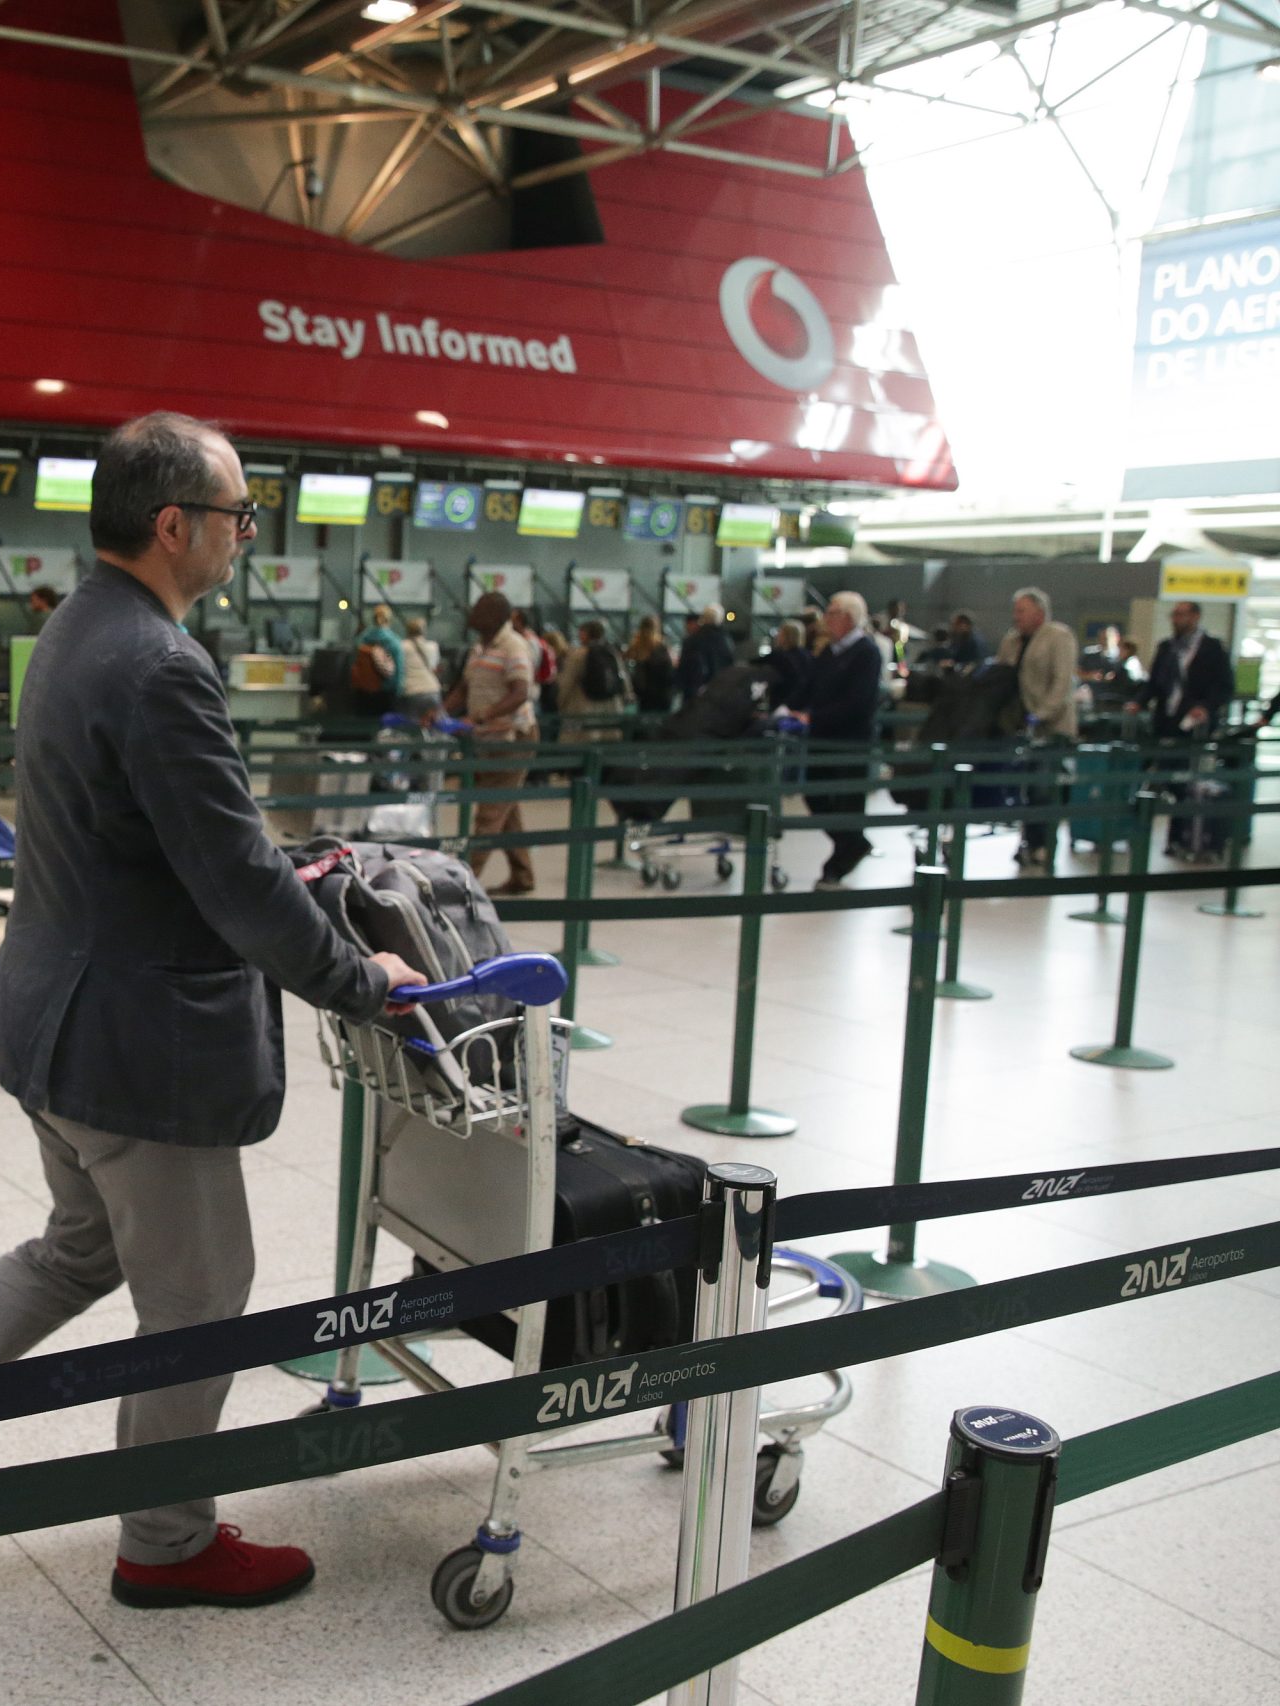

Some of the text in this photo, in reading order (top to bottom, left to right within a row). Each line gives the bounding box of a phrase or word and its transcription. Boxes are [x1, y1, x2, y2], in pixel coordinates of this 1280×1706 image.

[1152, 245, 1280, 302] PLANO
[1149, 302, 1210, 346] DO
[258, 300, 577, 374] Stay Informed
[1191, 1248, 1245, 1270] Aeroportos
[400, 1290, 454, 1311] Aeroportos
[400, 1303, 454, 1325] de Portugal
[639, 1362, 716, 1389] Aeroportos
[637, 1390, 663, 1404] Lisboa
